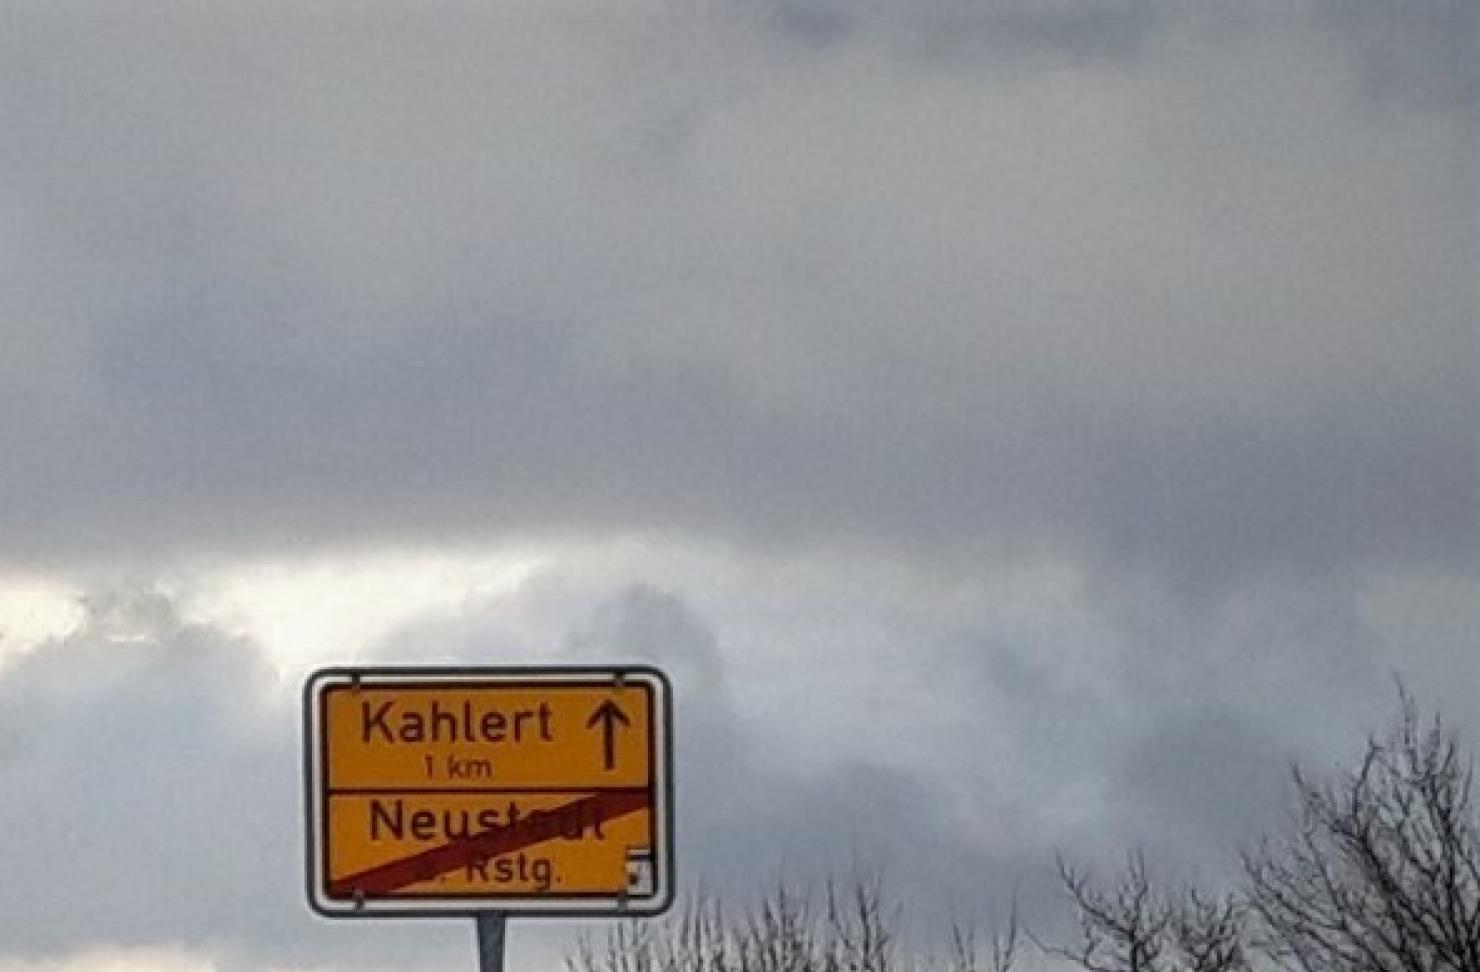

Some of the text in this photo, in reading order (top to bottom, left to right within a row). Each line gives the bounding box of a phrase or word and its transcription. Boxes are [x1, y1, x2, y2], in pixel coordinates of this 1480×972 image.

[361, 700, 554, 743] Kahlert
[424, 754, 493, 779] 1 km
